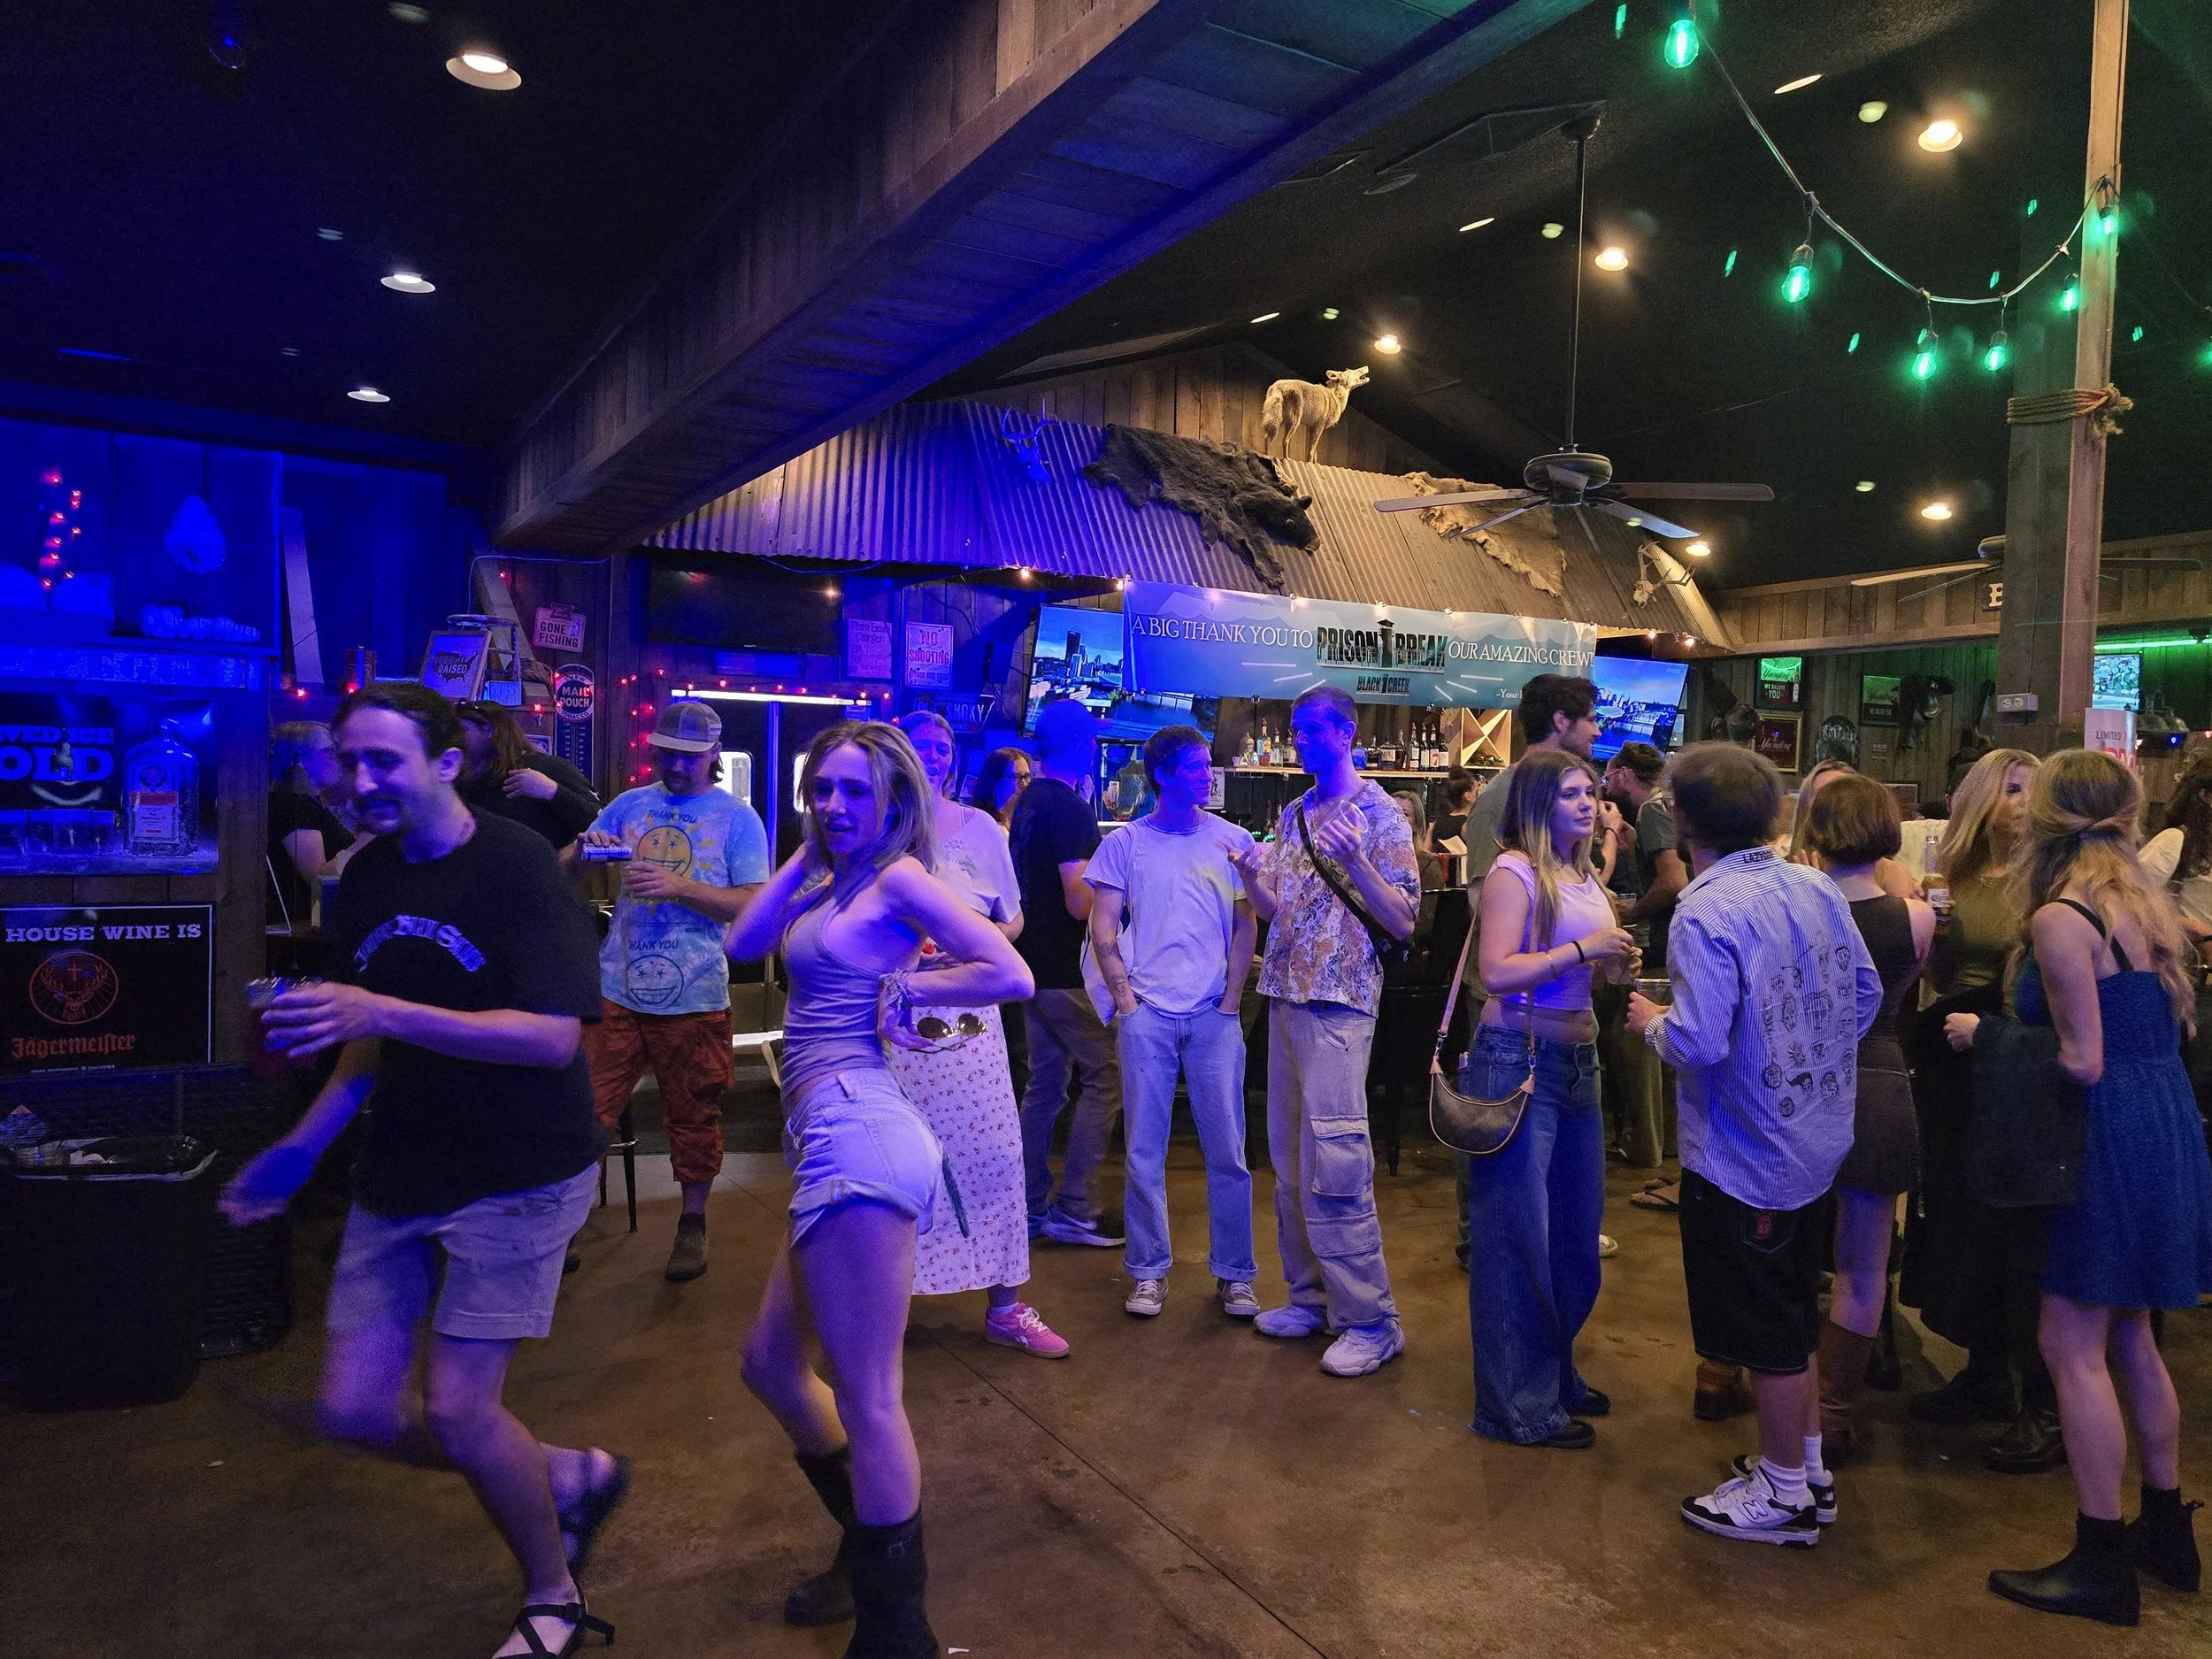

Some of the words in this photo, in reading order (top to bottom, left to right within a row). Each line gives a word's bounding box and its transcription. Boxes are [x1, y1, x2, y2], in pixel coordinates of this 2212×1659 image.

[541, 621, 566, 634] GONE
[539, 632, 579, 647] FISHING
[920, 630, 938, 645] NO
[1132, 615, 1147, 635] A
[1148, 617, 1179, 638] BIG
[1183, 620, 1246, 643] THANK
[1249, 626, 1288, 647] YOU
[1291, 629, 1314, 649] TO
[1317, 626, 1379, 663] PRISON
[1394, 633, 1448, 667] BREAK
[1448, 641, 1479, 660] OUR
[1479, 643, 1548, 664] AMAZING
[910, 648, 949, 665] SHOOTING
[437, 664, 468, 674] RAISED
[562, 687, 589, 696] MAIL
[1357, 676, 1382, 692] BLACK
[1386, 678, 1410, 693] CREEK
[1769, 689, 1781, 699] YOU
[560, 696, 589, 707] POUCH
[561, 710, 589, 719] TOBACCO
[946, 703, 985, 722] SMOKY
[67, 727, 114, 744] ICE
[2095, 730, 2122, 741] LIMITED
[647, 810, 677, 821] THANK
[678, 812, 699, 824] YOU
[5, 926, 96, 942] HOUSE
[102, 925, 171, 940] WINE
[177, 923, 203, 939] IS
[629, 940, 657, 951] HANK
[657, 939, 680, 950] YOU
